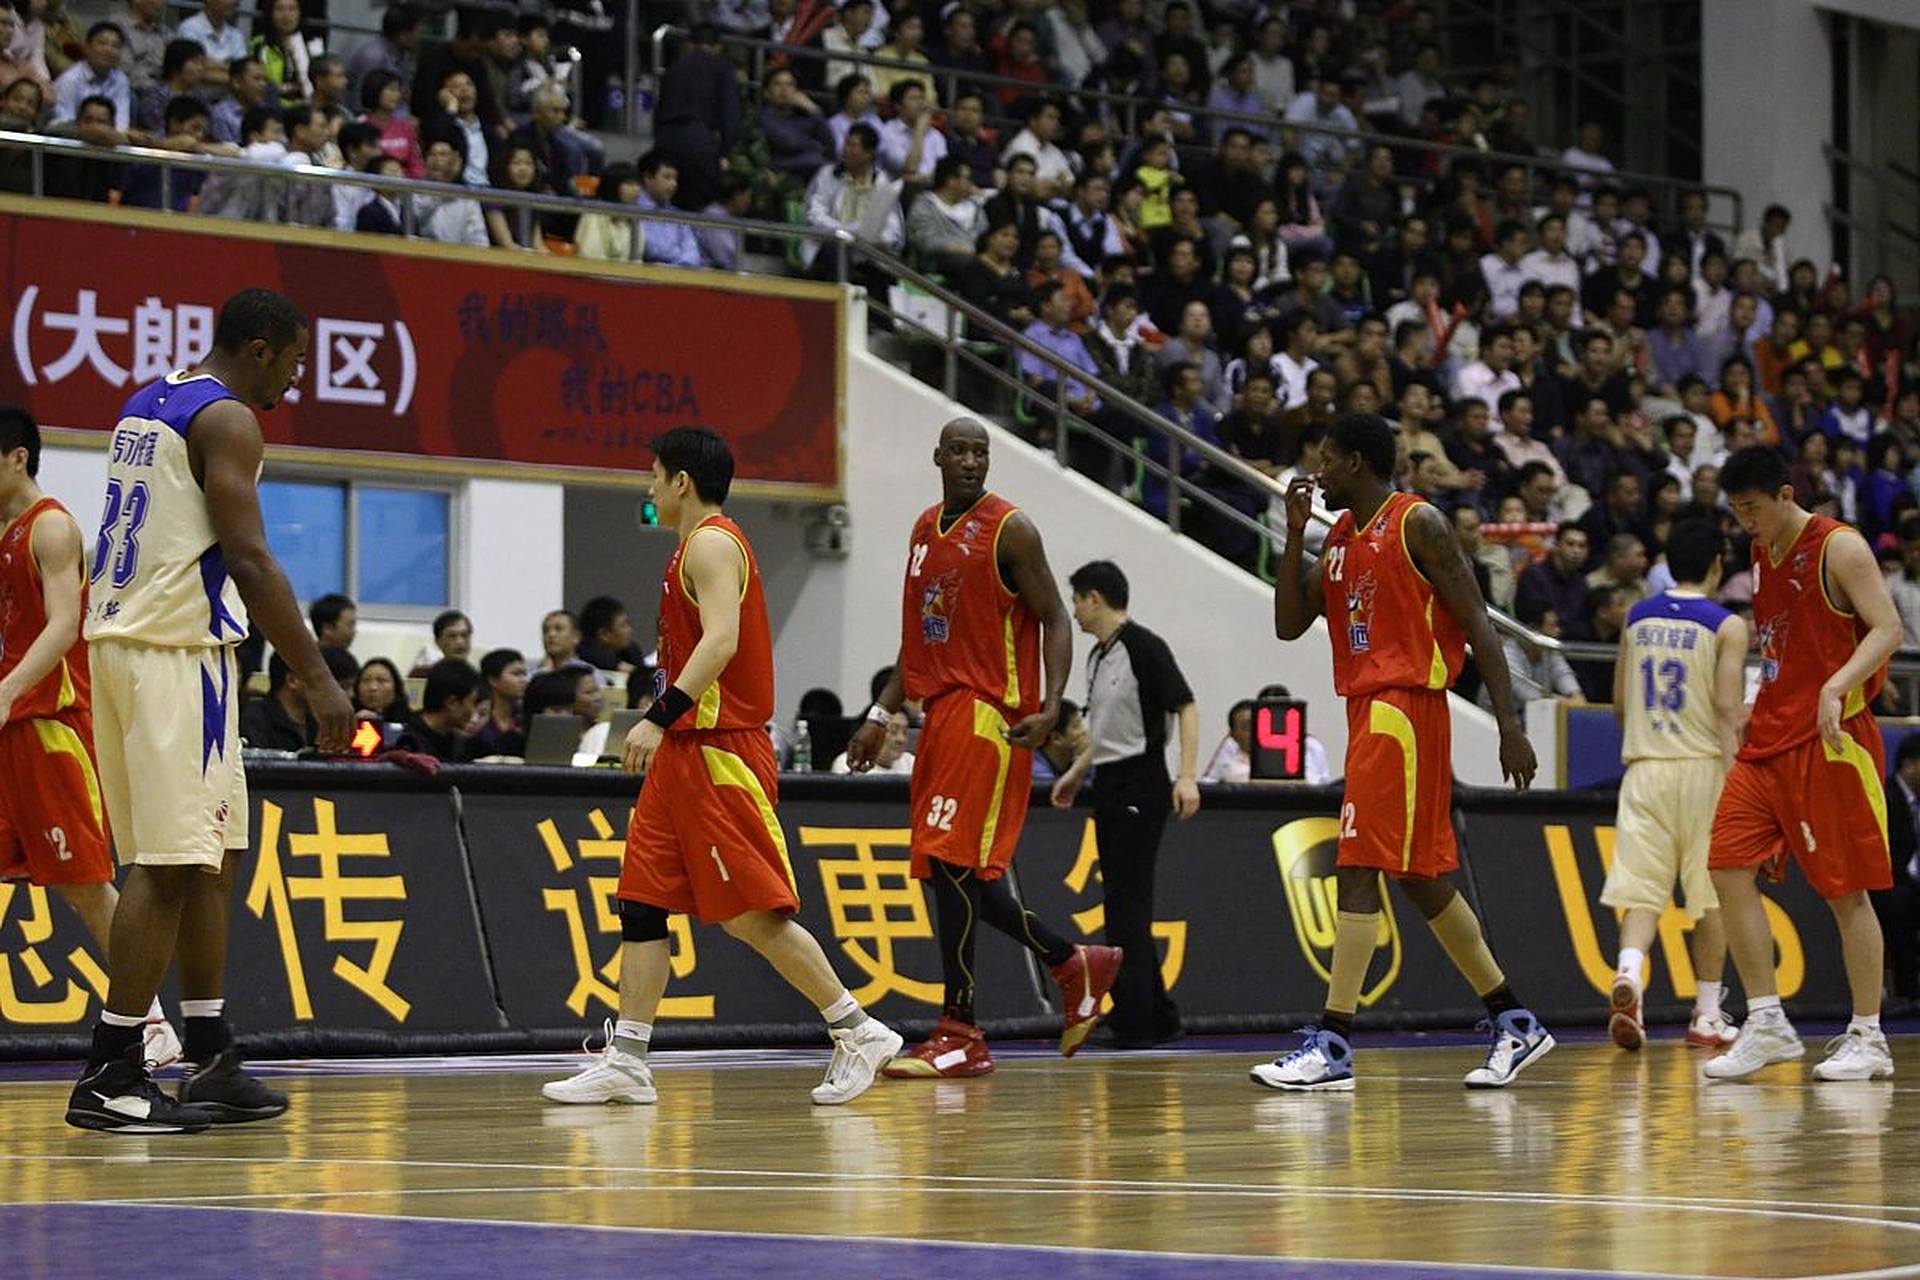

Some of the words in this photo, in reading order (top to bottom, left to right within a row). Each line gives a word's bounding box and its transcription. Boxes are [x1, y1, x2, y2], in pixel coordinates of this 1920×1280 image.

[13, 285, 417, 415] (大朗区)
[1640, 655, 1687, 714] 13
[1257, 706, 1301, 775] 4
[926, 794, 958, 832] 32
